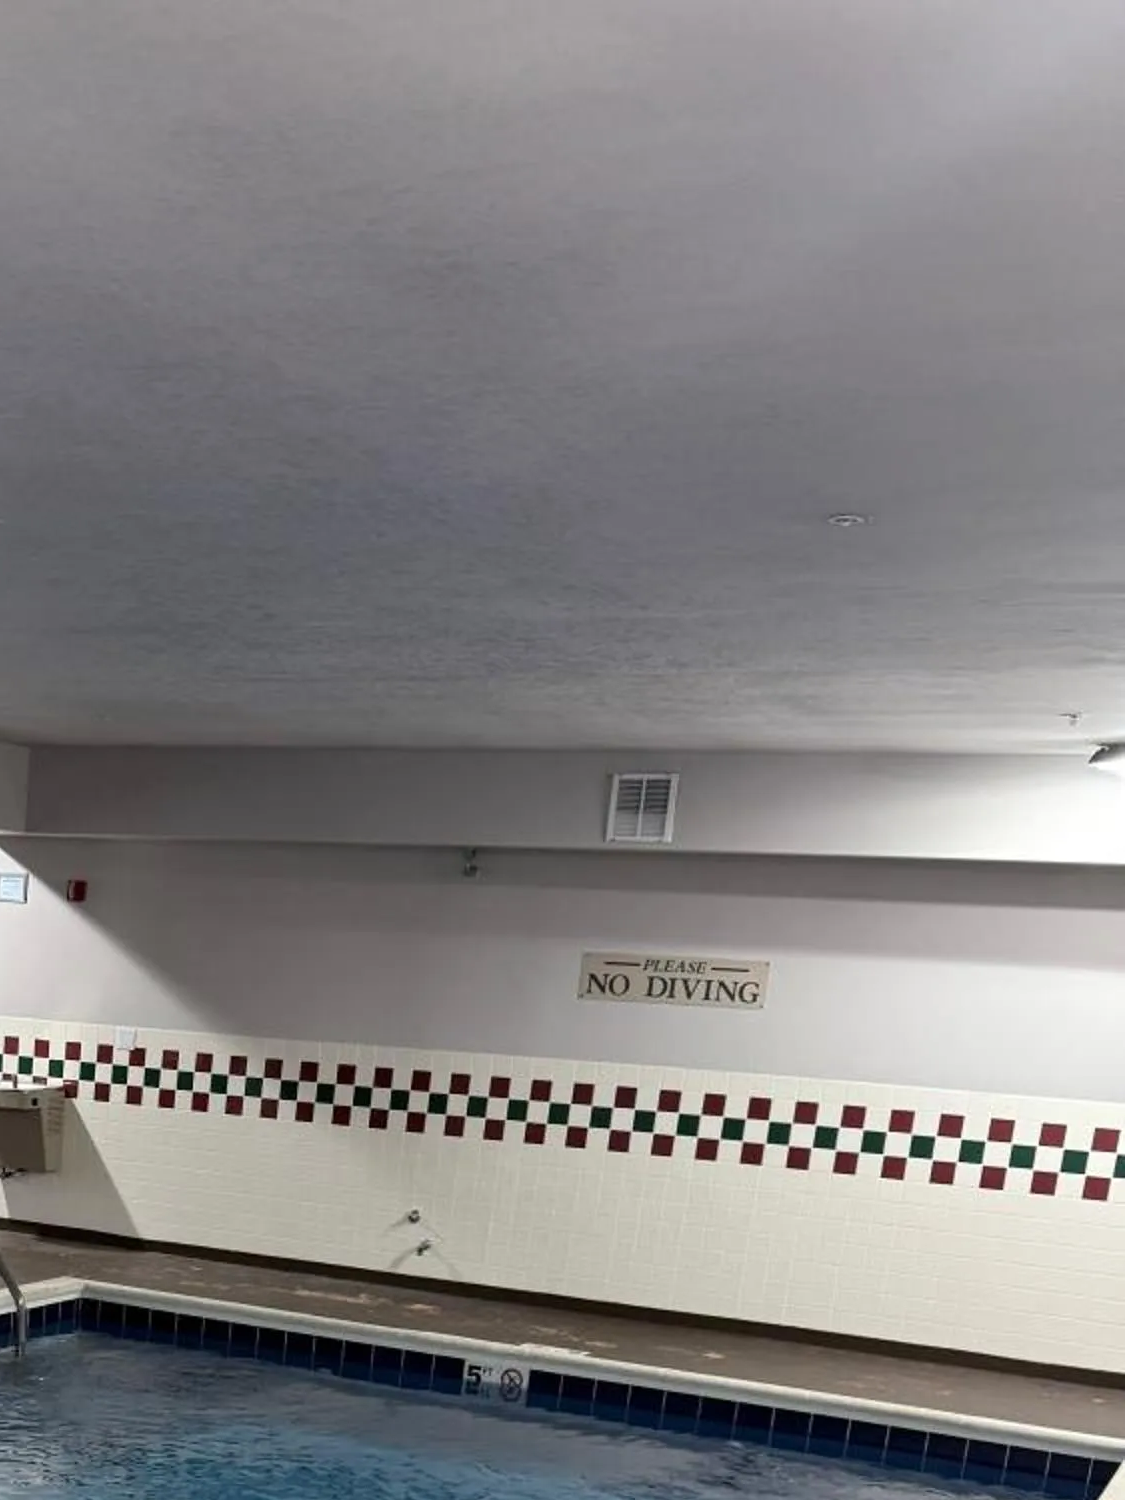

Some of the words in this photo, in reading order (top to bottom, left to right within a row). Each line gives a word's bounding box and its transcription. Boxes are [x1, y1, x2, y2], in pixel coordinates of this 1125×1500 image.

[642, 958, 707, 975] PLEASE
[586, 972, 631, 997] NO
[645, 975, 761, 1005] DIVING
